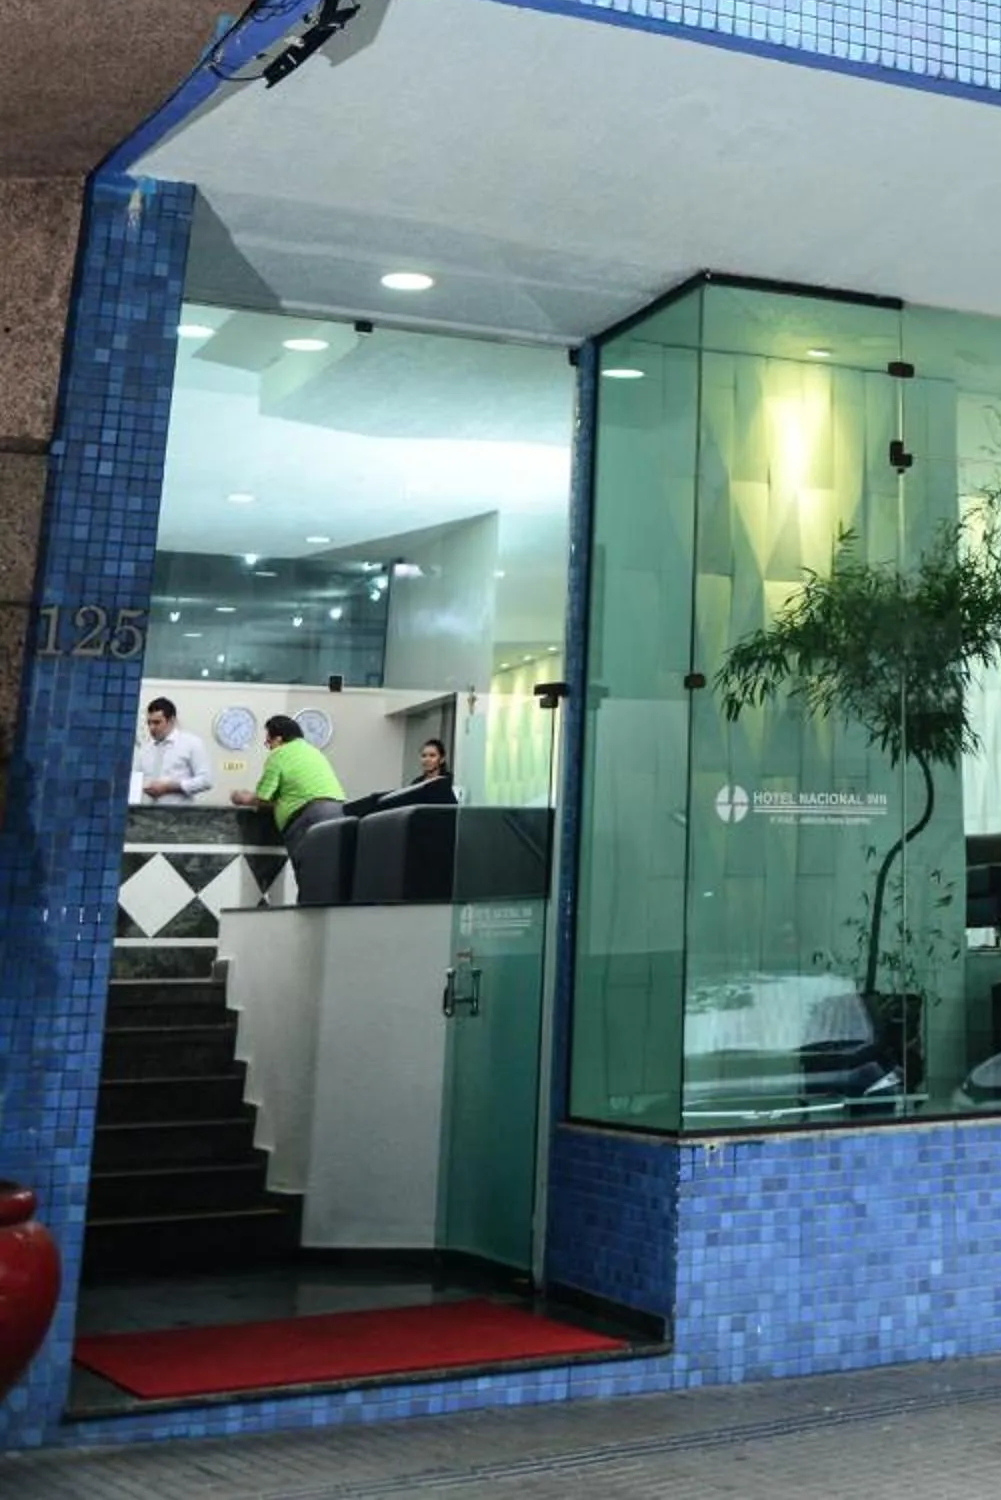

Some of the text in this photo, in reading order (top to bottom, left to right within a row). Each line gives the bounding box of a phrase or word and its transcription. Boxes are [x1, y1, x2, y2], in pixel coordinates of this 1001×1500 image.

[37, 604, 145, 659] 125
[753, 791, 887, 805] HOTEL NACIONAL INN
